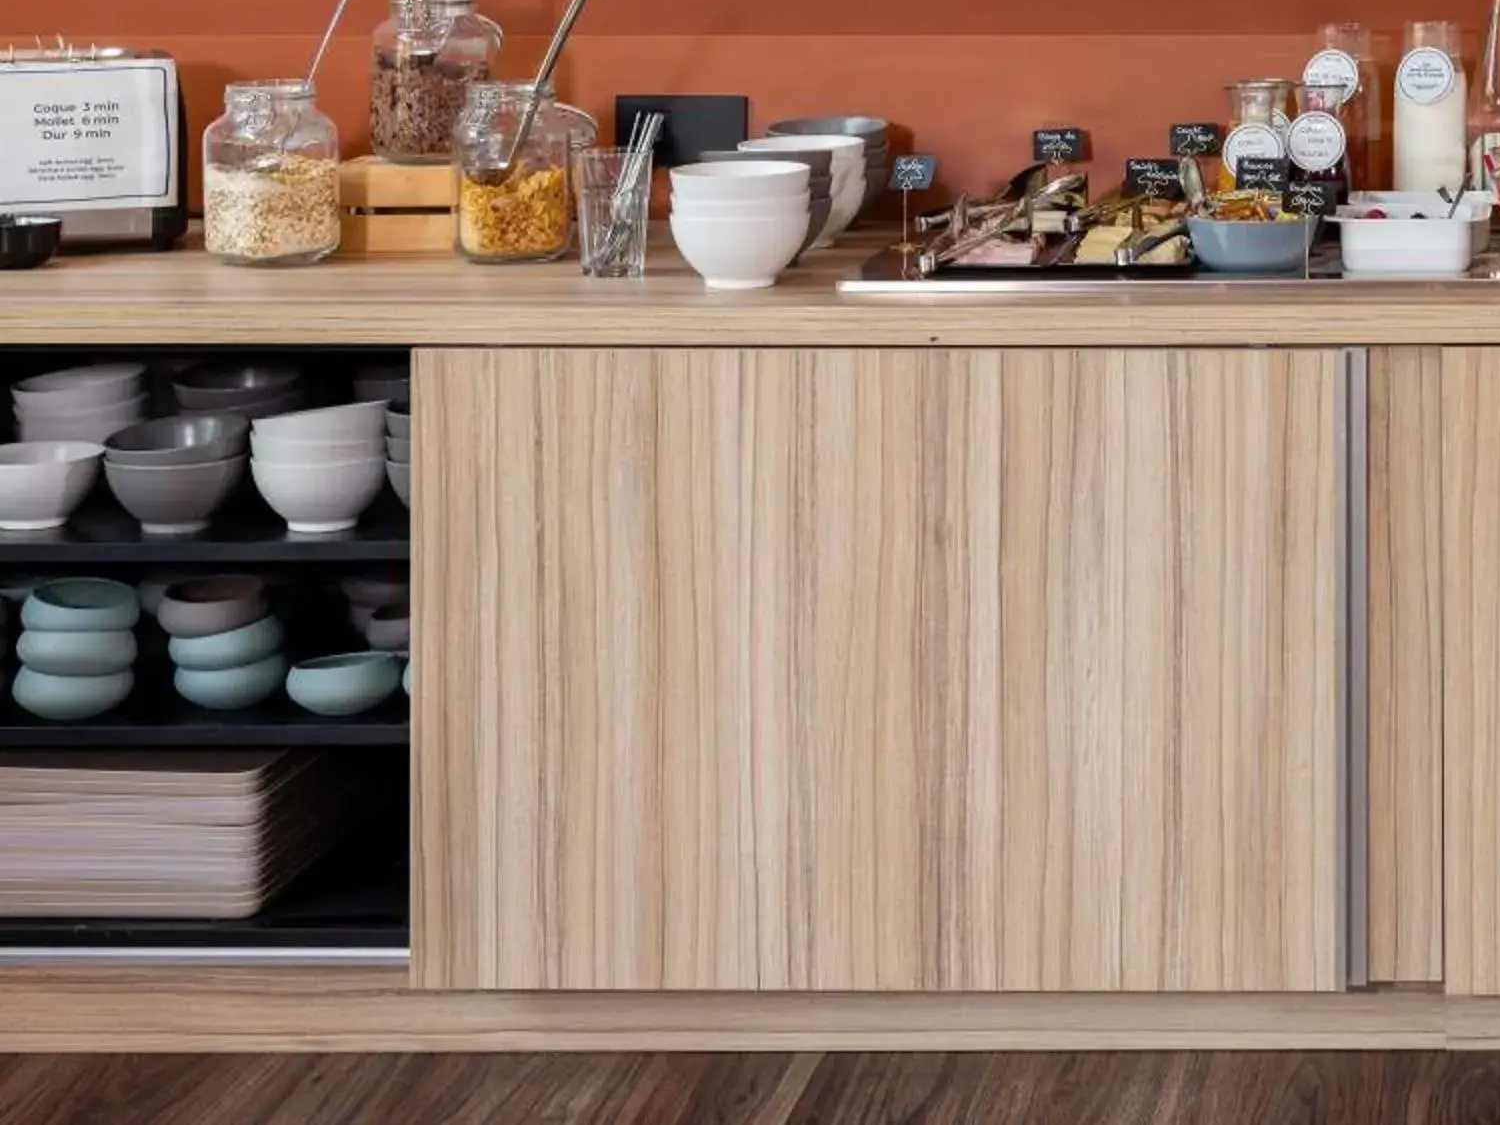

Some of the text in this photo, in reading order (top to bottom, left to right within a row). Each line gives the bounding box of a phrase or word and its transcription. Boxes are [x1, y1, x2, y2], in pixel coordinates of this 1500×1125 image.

[33, 100, 119, 114] Coque 3 min
[34, 115, 119, 126] Mollet 6 min
[42, 128, 111, 140] Dur 9 min
